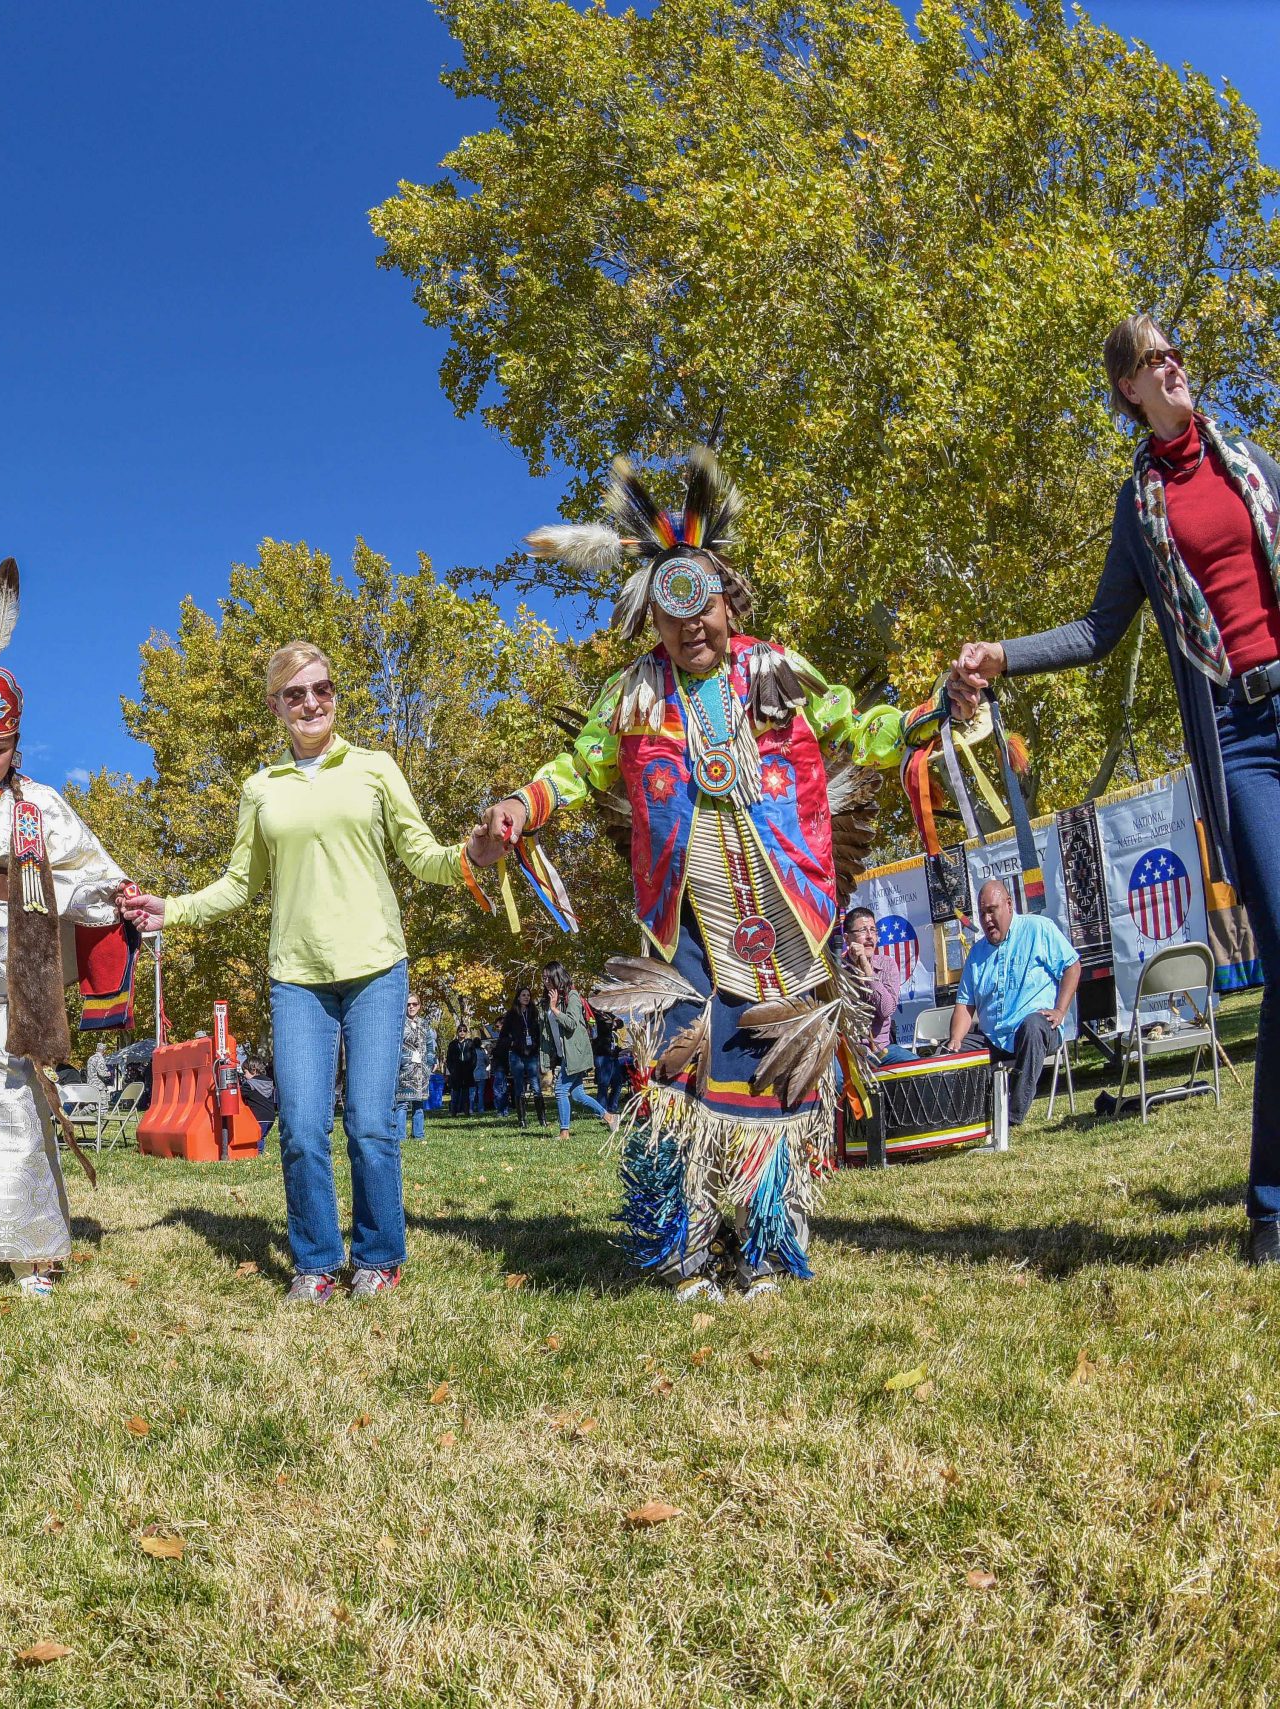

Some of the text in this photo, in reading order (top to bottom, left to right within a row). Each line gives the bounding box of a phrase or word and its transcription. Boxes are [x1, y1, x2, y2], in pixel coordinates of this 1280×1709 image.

[1132, 810, 1166, 830] NATIONAL
[1117, 818, 1186, 849] NATIVE AMERICAN
[982, 848, 1046, 879] DIVERY
[872, 884, 901, 899] NATIONAL
[887, 892, 918, 907] AMERICAN
